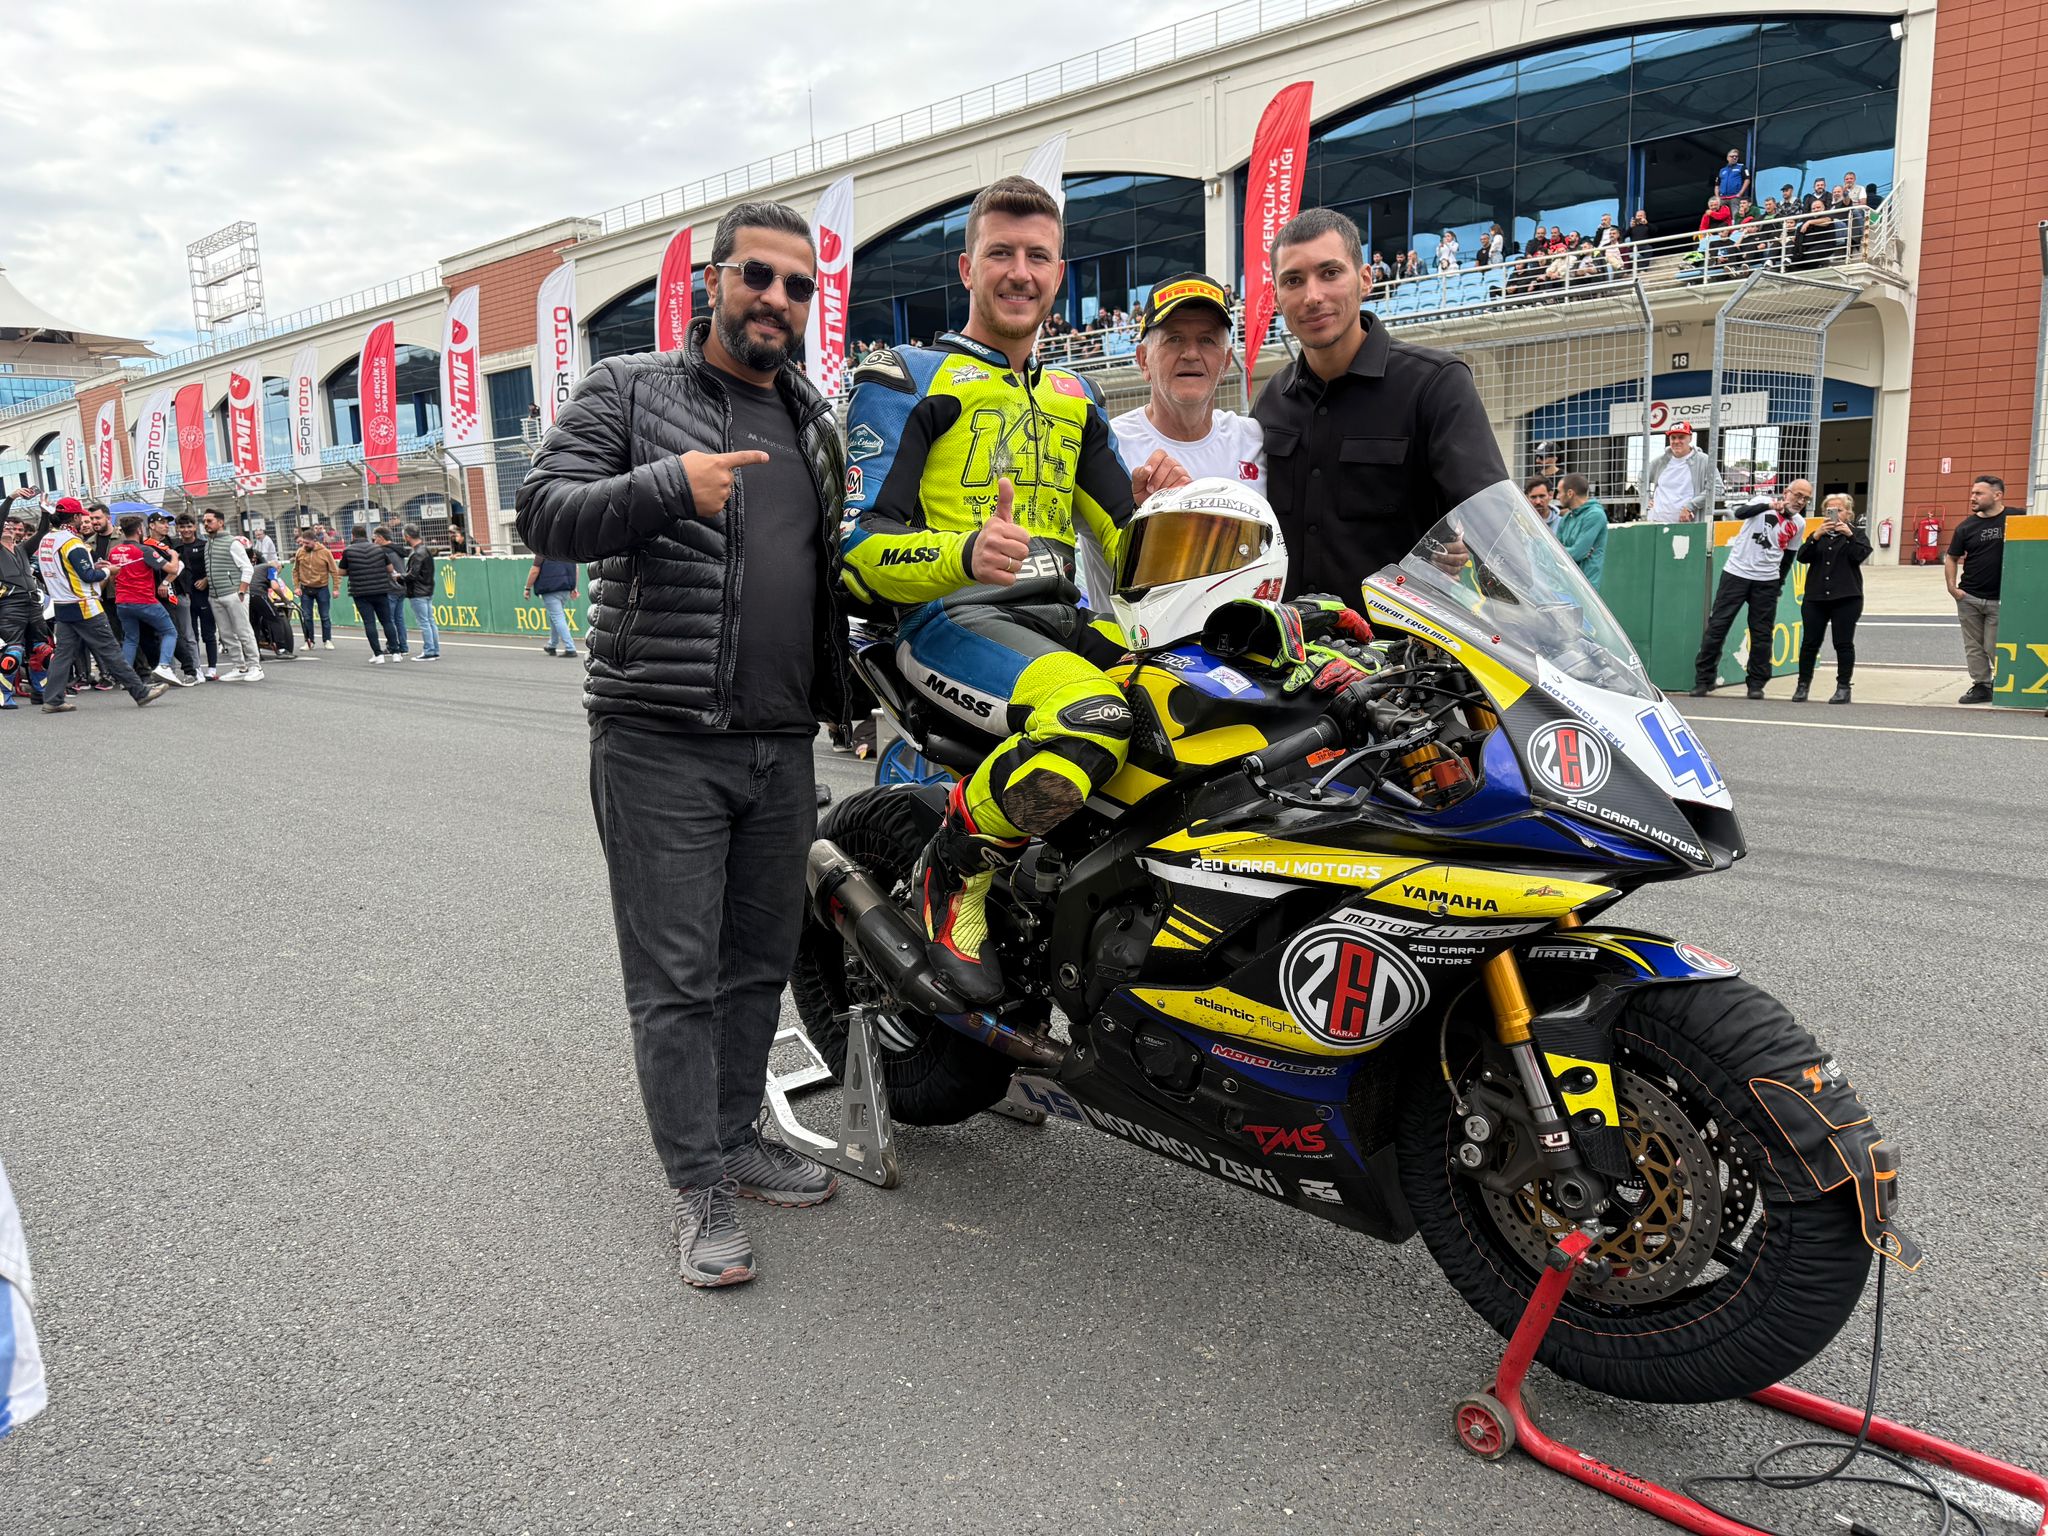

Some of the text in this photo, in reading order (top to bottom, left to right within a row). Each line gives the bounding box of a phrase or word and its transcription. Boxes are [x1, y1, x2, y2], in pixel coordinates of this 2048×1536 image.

[1269, 158, 1279, 178] VE
[1278, 148, 1294, 231] AKANLIĞI
[1262, 183, 1278, 253] GENÇLİK
[824, 276, 843, 344] TMF
[952, 335, 991, 355] MASS
[1673, 355, 1688, 367] 18
[452, 354, 470, 403] TMF
[1672, 402, 1732, 416] TOSFD
[237, 410, 253, 463] TMF
[875, 546, 941, 567] MASS
[514, 607, 580, 632] ROLX
[1368, 599, 1404, 619] FURKAN
[920, 673, 997, 718] MASS
[1540, 681, 1599, 726] MOTORCU
[1566, 797, 1705, 861] ZED GARAJ MOTORS
[1190, 857, 1382, 880] ZED GARAJ MOTORS
[1401, 884, 1499, 913] YAMAHA
[1343, 912, 1460, 939] MOTORCU
[1409, 943, 1485, 955] ZED GARAJ
[1416, 955, 1472, 965] MOTORS
[1528, 945, 1599, 961] PIRELLI
[1297, 941, 1412, 1039] ZED
[1194, 996, 1302, 1036] atlantic flight
[1329, 1027, 1360, 1038] GARAJ
[1083, 1103, 1211, 1169] MOTORCU
[1242, 1123, 1326, 1156] TMS
